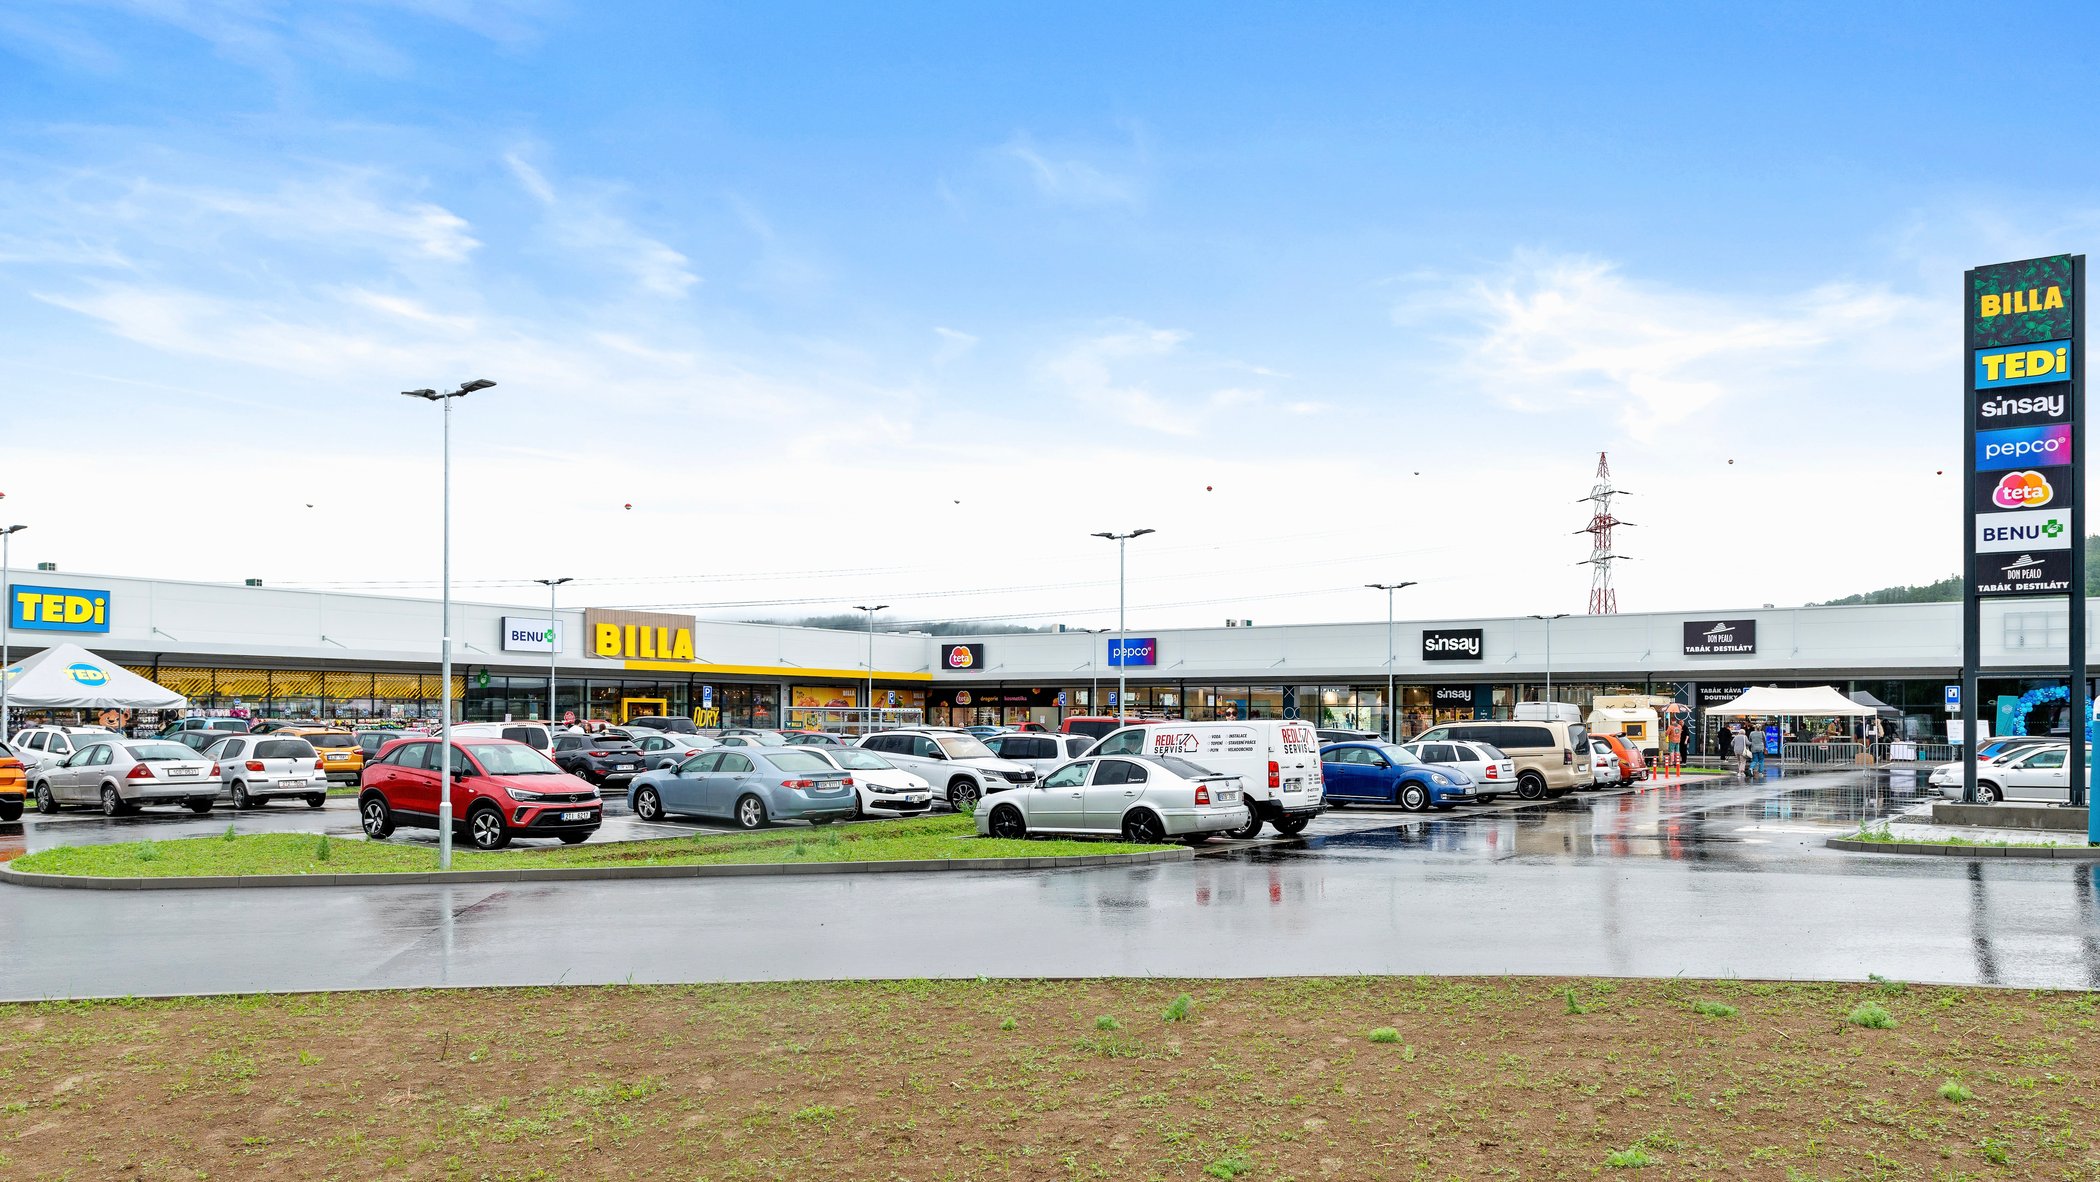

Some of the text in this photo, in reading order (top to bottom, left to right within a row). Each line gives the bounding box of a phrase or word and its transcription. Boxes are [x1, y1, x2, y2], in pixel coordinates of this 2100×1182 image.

[1981, 286, 2064, 317] BILLA
[1982, 347, 2066, 381] TEDi
[1981, 394, 2064, 417] sinsay
[2003, 485, 2044, 500] teta
[1983, 525, 2039, 542] BENU
[2007, 568, 2042, 580] DON PEALO
[1978, 580, 2070, 592] TABÁK DESTILÁTY
[17, 592, 106, 625] TEDi
[512, 630, 543, 642] BENU
[596, 623, 695, 660] BILLA
[1707, 634, 1733, 643] DON PEALO
[1425, 634, 1480, 655] sinsay
[1686, 644, 1753, 653] TABÁK DESTILÁTY
[953, 654, 970, 663] teta
[63, 667, 112, 682] TEDi
[705, 687, 711, 697] P
[1060, 693, 1065, 701] P
[1110, 693, 1116, 702] P
[1436, 687, 1472, 701] sinsay
[693, 706, 720, 727] ODRY
[1154, 746, 1183, 754] SERVIS
[1284, 744, 1308, 754] SERVIS
